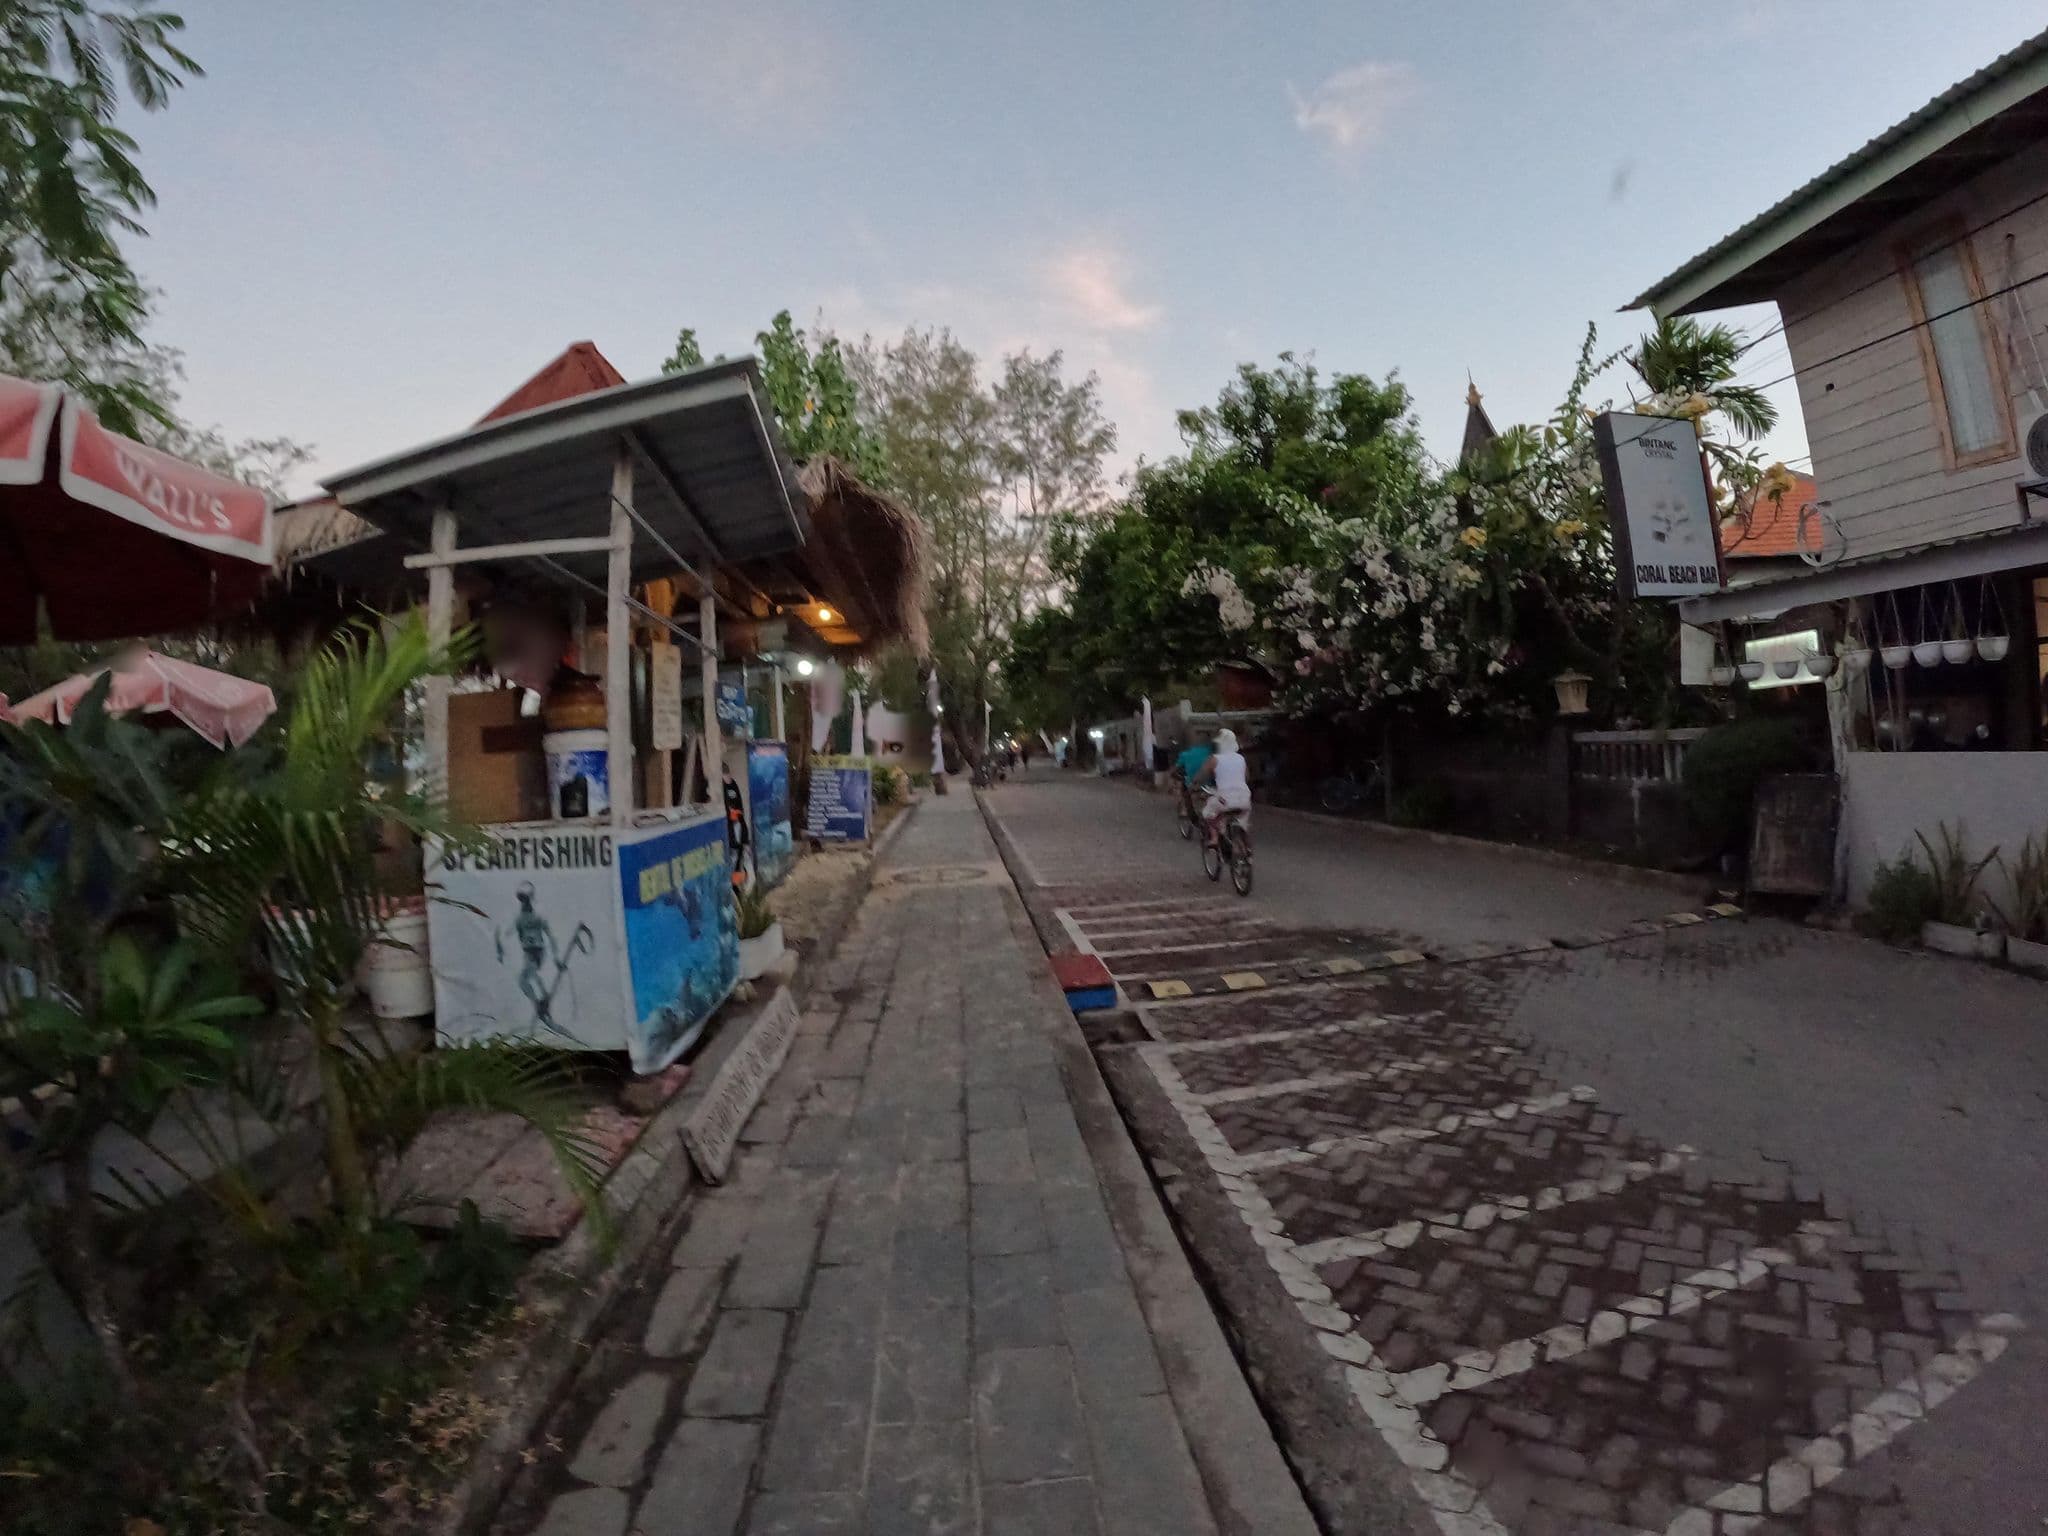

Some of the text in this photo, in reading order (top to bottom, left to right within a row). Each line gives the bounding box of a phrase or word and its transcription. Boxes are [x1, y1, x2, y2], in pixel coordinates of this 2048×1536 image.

[114, 445, 232, 530] WALL'S
[1636, 565, 1719, 584] CORAL BEACH BAR
